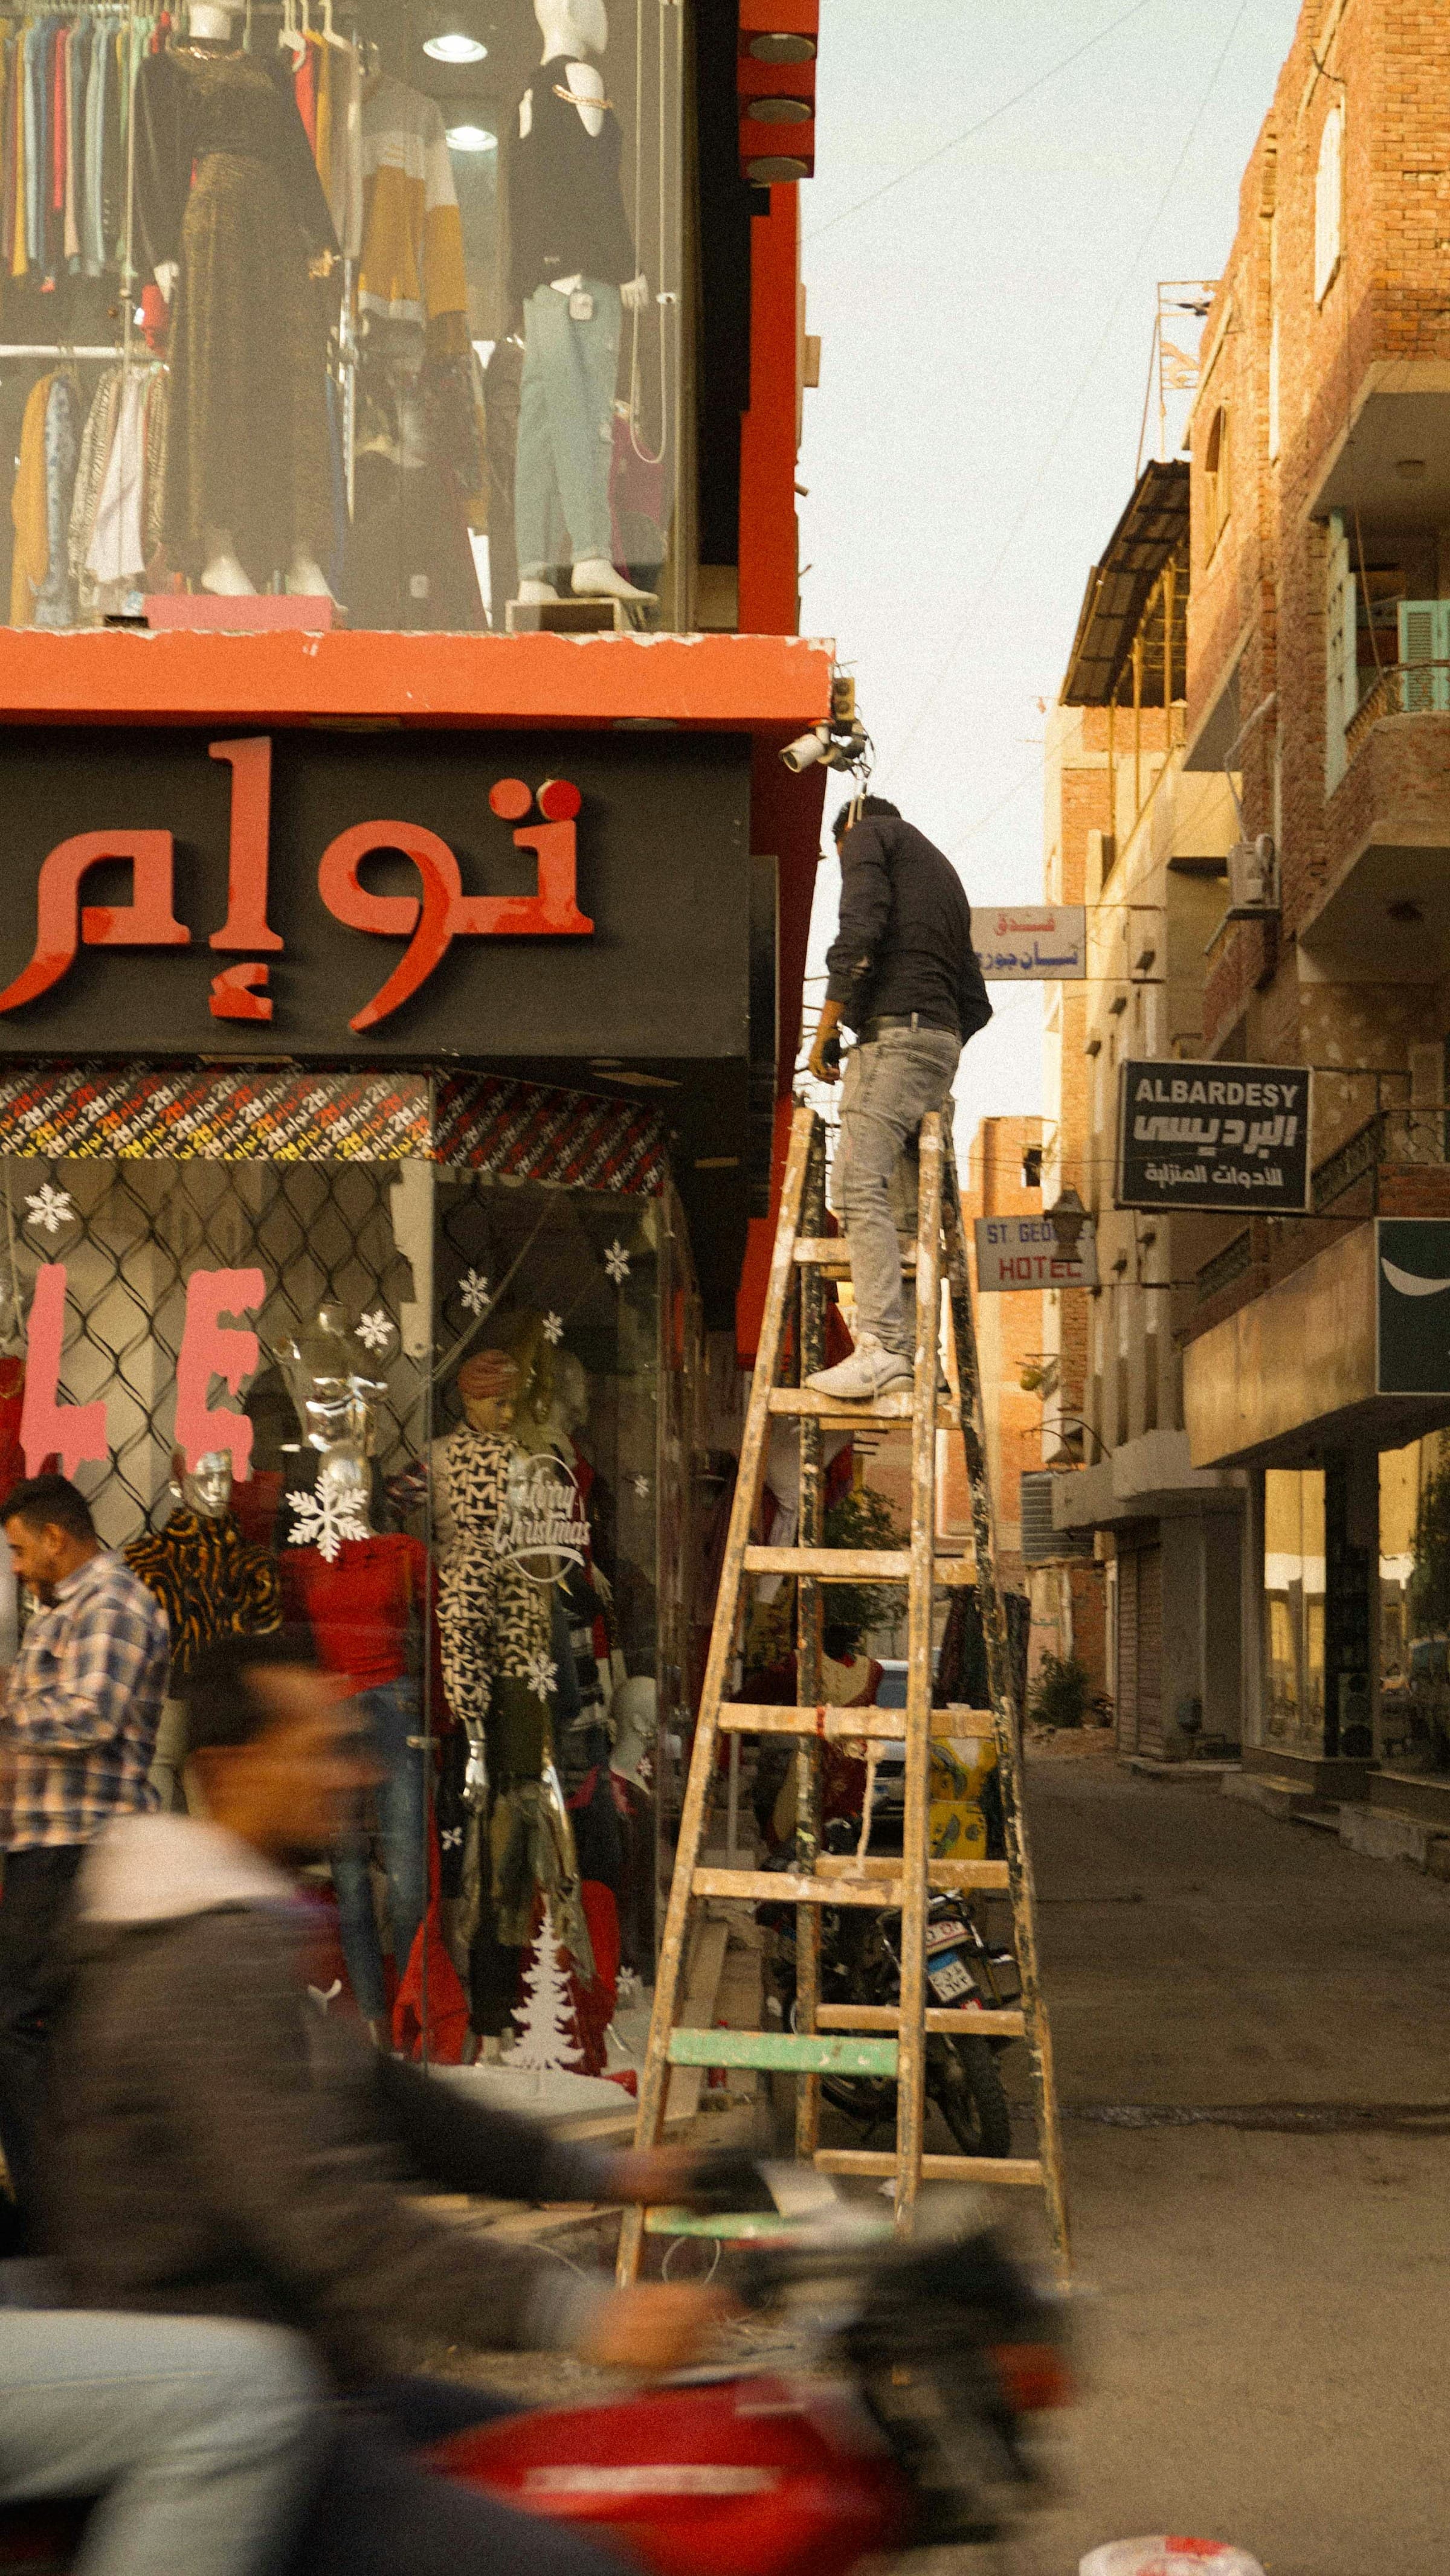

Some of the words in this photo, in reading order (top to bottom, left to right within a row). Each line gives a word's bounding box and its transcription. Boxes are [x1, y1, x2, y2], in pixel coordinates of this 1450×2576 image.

[0, 735, 595, 1033] توإم
[1135, 1078, 1298, 1108] ALBARDESY
[998, 1256, 1081, 1280] HOTEL
